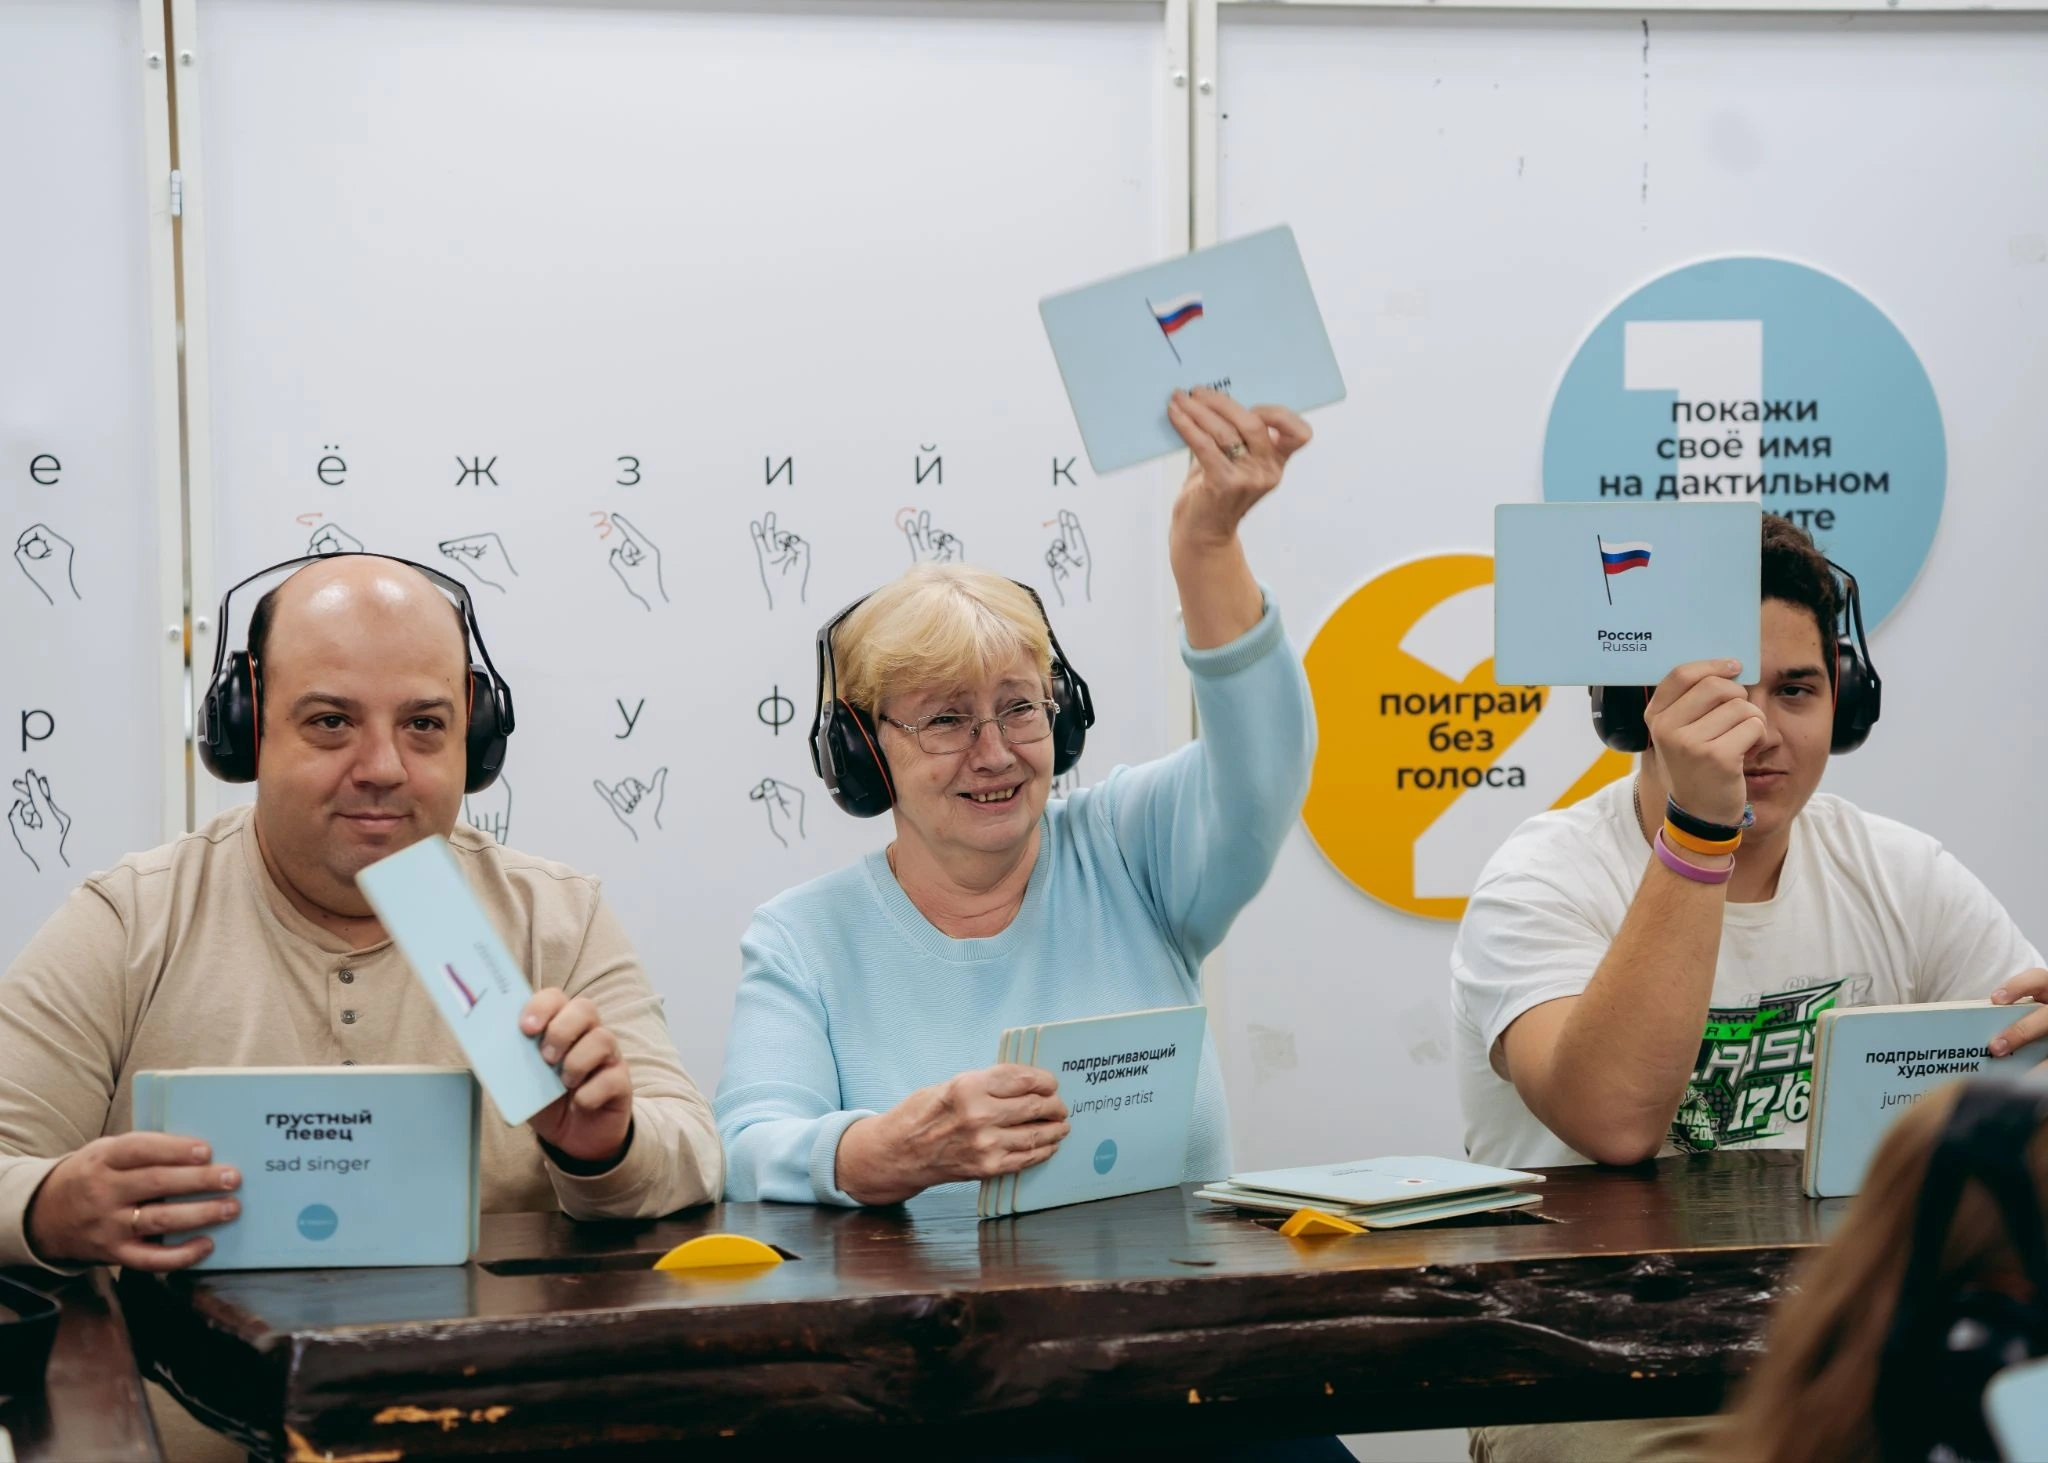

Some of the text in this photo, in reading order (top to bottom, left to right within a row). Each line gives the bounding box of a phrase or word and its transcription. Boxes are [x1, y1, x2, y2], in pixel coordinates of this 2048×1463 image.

[1671, 400, 1818, 422] покажи
[1656, 429, 1832, 460] своё имя
[29, 453, 62, 486] е
[317, 444, 348, 486] ё
[455, 455, 500, 487] ж
[615, 455, 642, 486] з
[765, 456, 794, 486] и
[915, 444, 943, 486] й
[1053, 456, 1078, 486] к
[1599, 471, 1890, 500] на дактильном
[1597, 629, 1653, 641] Россия
[1602, 640, 1648, 652] Russia
[757, 684, 796, 737] ф
[1380, 685, 1542, 722] поиграй
[21, 709, 56, 753] р
[615, 698, 646, 740] у
[1428, 721, 1495, 752] без
[1396, 766, 1526, 790] голоса
[1061, 1043, 1177, 1072] подпрыгивающий
[1865, 1046, 2014, 1064] подпрыгивающ
[1084, 1063, 1149, 1085] художник
[1896, 1061, 1980, 1079] художник
[1070, 1090, 1154, 1117] jumping artist
[265, 1109, 373, 1129] грустный
[284, 1127, 354, 1142] певец
[264, 1156, 372, 1175] sad singer
